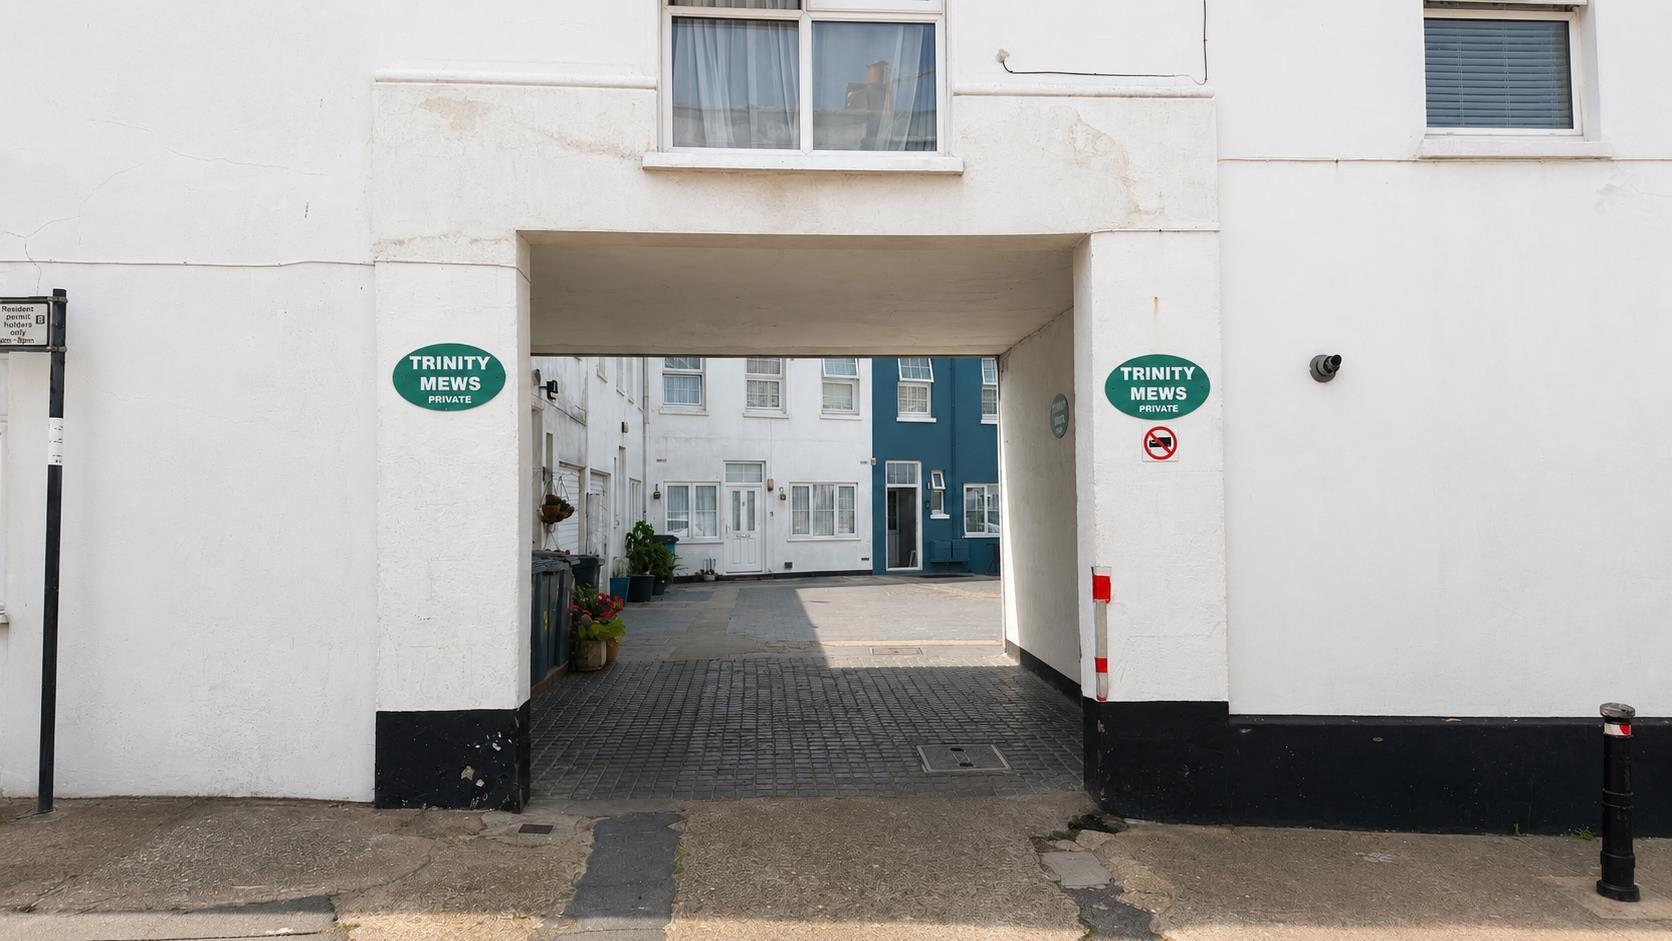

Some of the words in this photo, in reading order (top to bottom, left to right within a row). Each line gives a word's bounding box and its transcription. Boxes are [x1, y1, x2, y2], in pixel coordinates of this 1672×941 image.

[3, 321, 33, 329] holders
[409, 355, 491, 370] TRINITY
[1120, 367, 1195, 380] TRINITY
[420, 376, 481, 391] MEWS
[428, 395, 472, 404] PRIVATE
[1130, 386, 1187, 401] MEWS
[1139, 404, 1179, 412] PRIVATE
